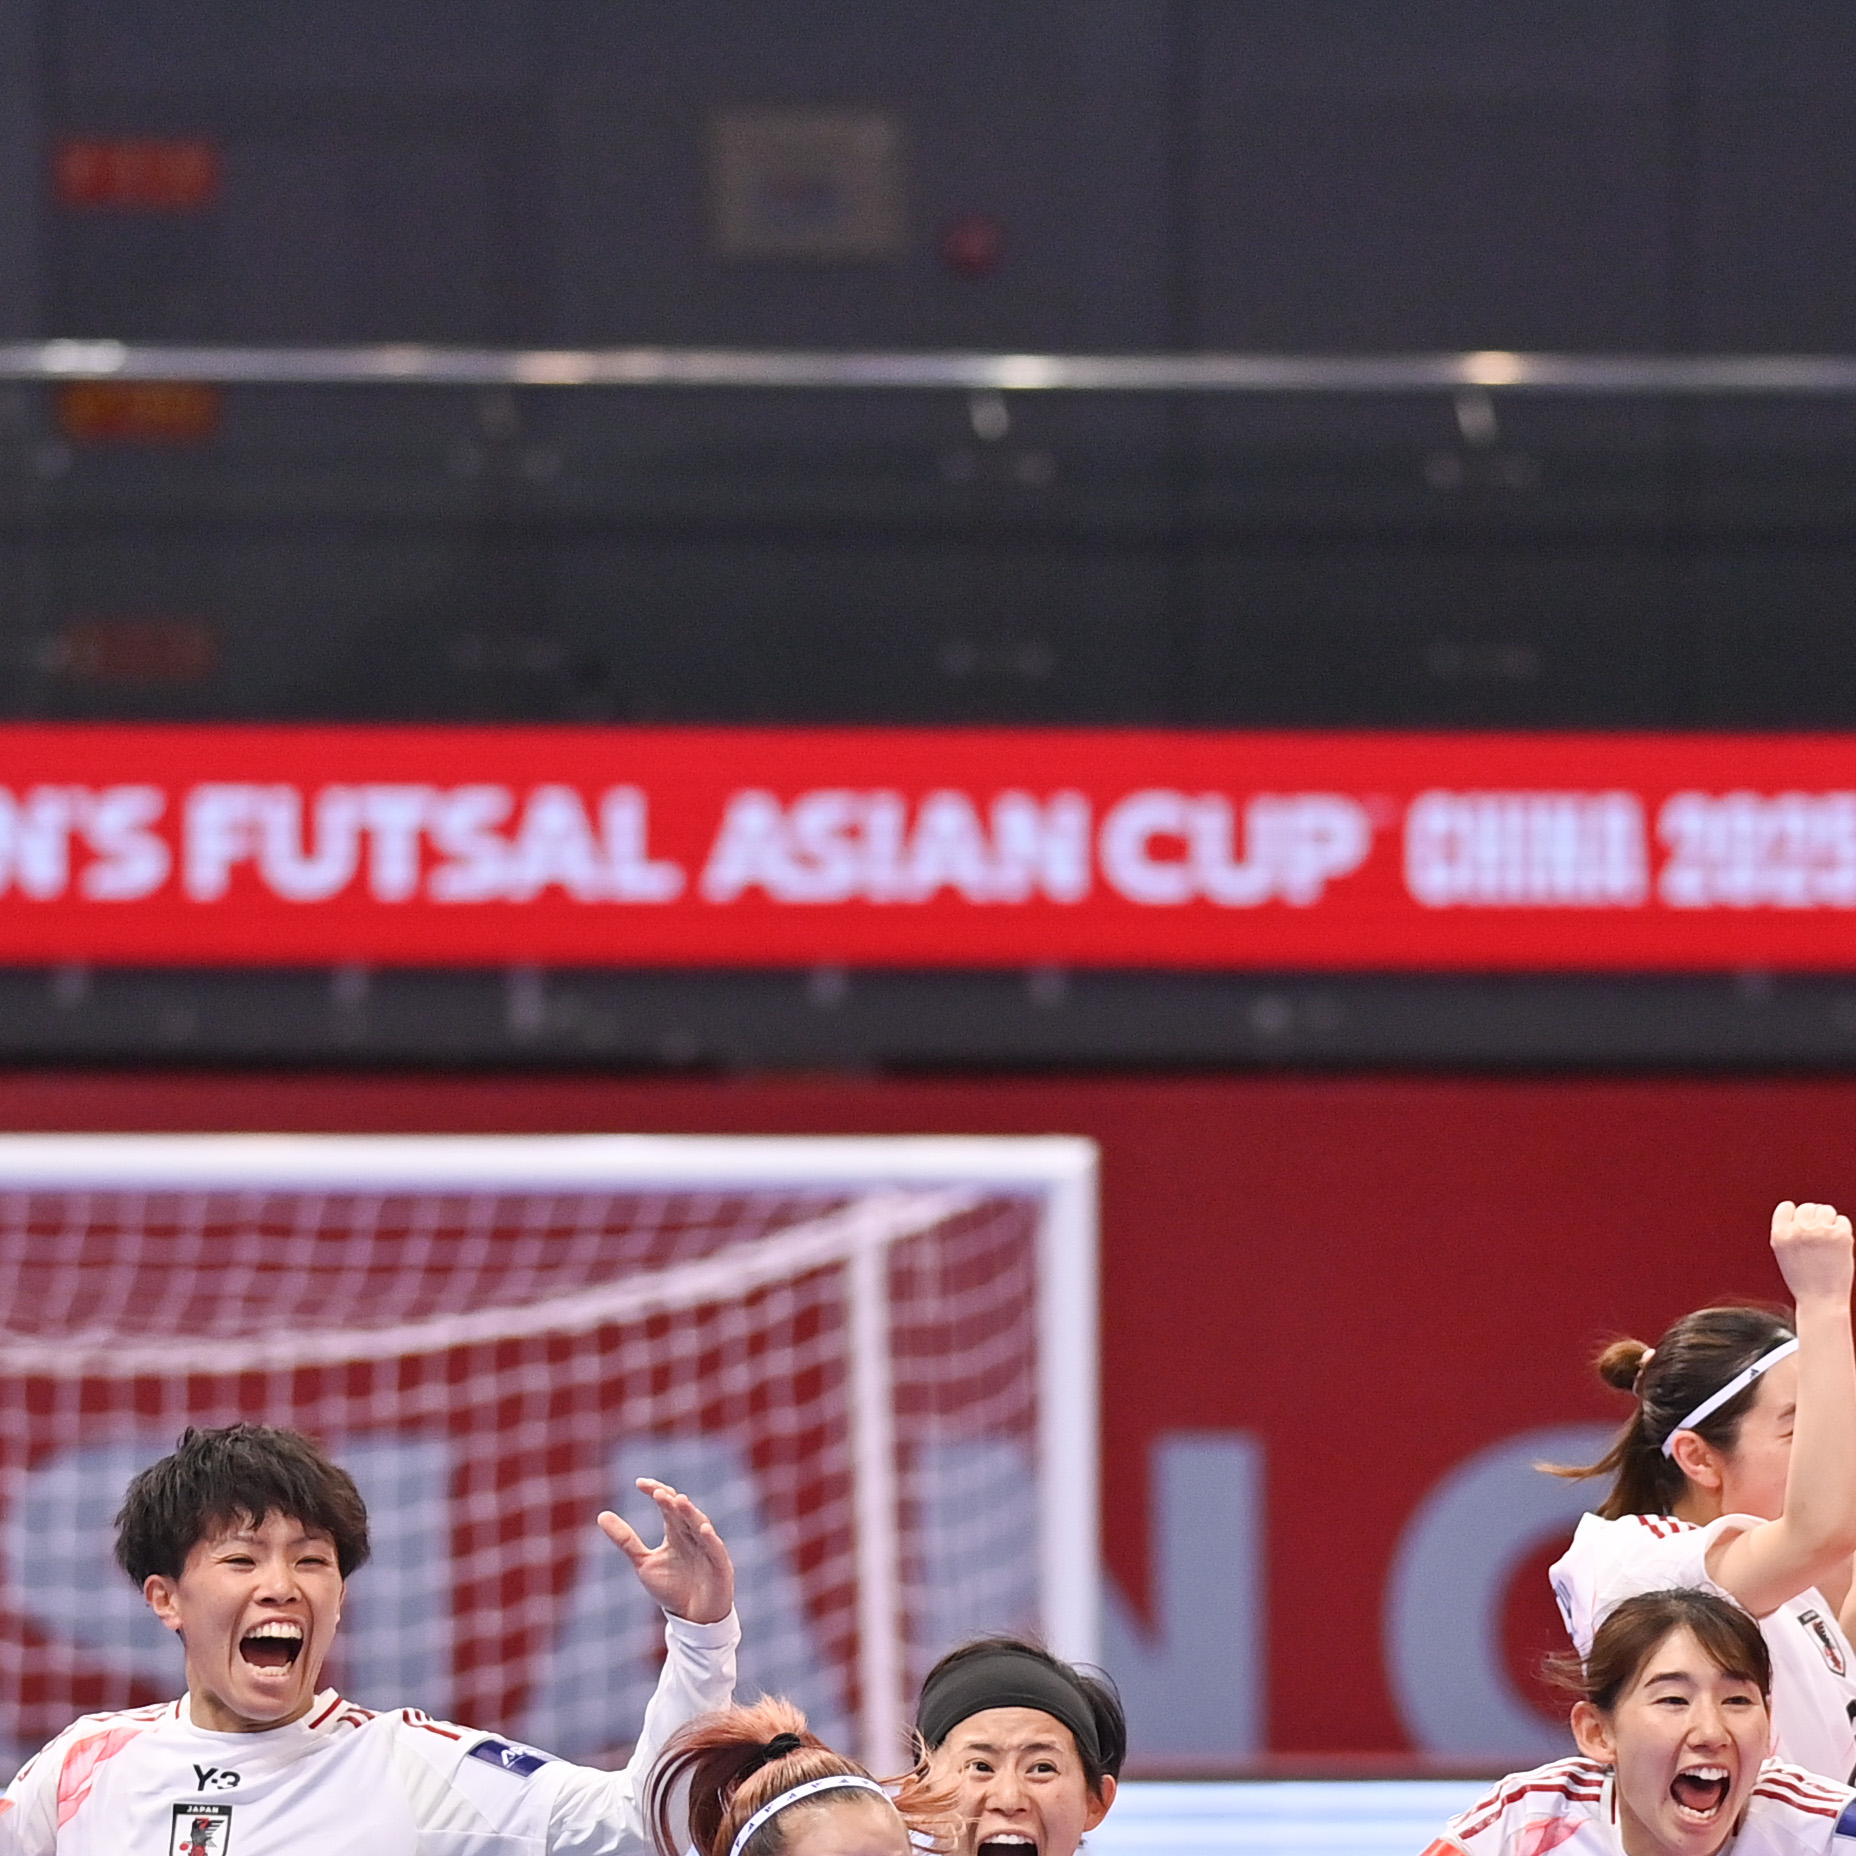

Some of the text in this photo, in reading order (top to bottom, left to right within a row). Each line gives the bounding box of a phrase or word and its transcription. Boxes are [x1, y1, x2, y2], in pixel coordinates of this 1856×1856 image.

[180, 780, 686, 905] FUTSAL
[697, 785, 1097, 908] ASIAN
[1097, 788, 1374, 908] CUP
[1401, 788, 1650, 910] CHINA
[193, 1763, 241, 1792] Y-3
[186, 1804, 219, 1815] JAPAN
